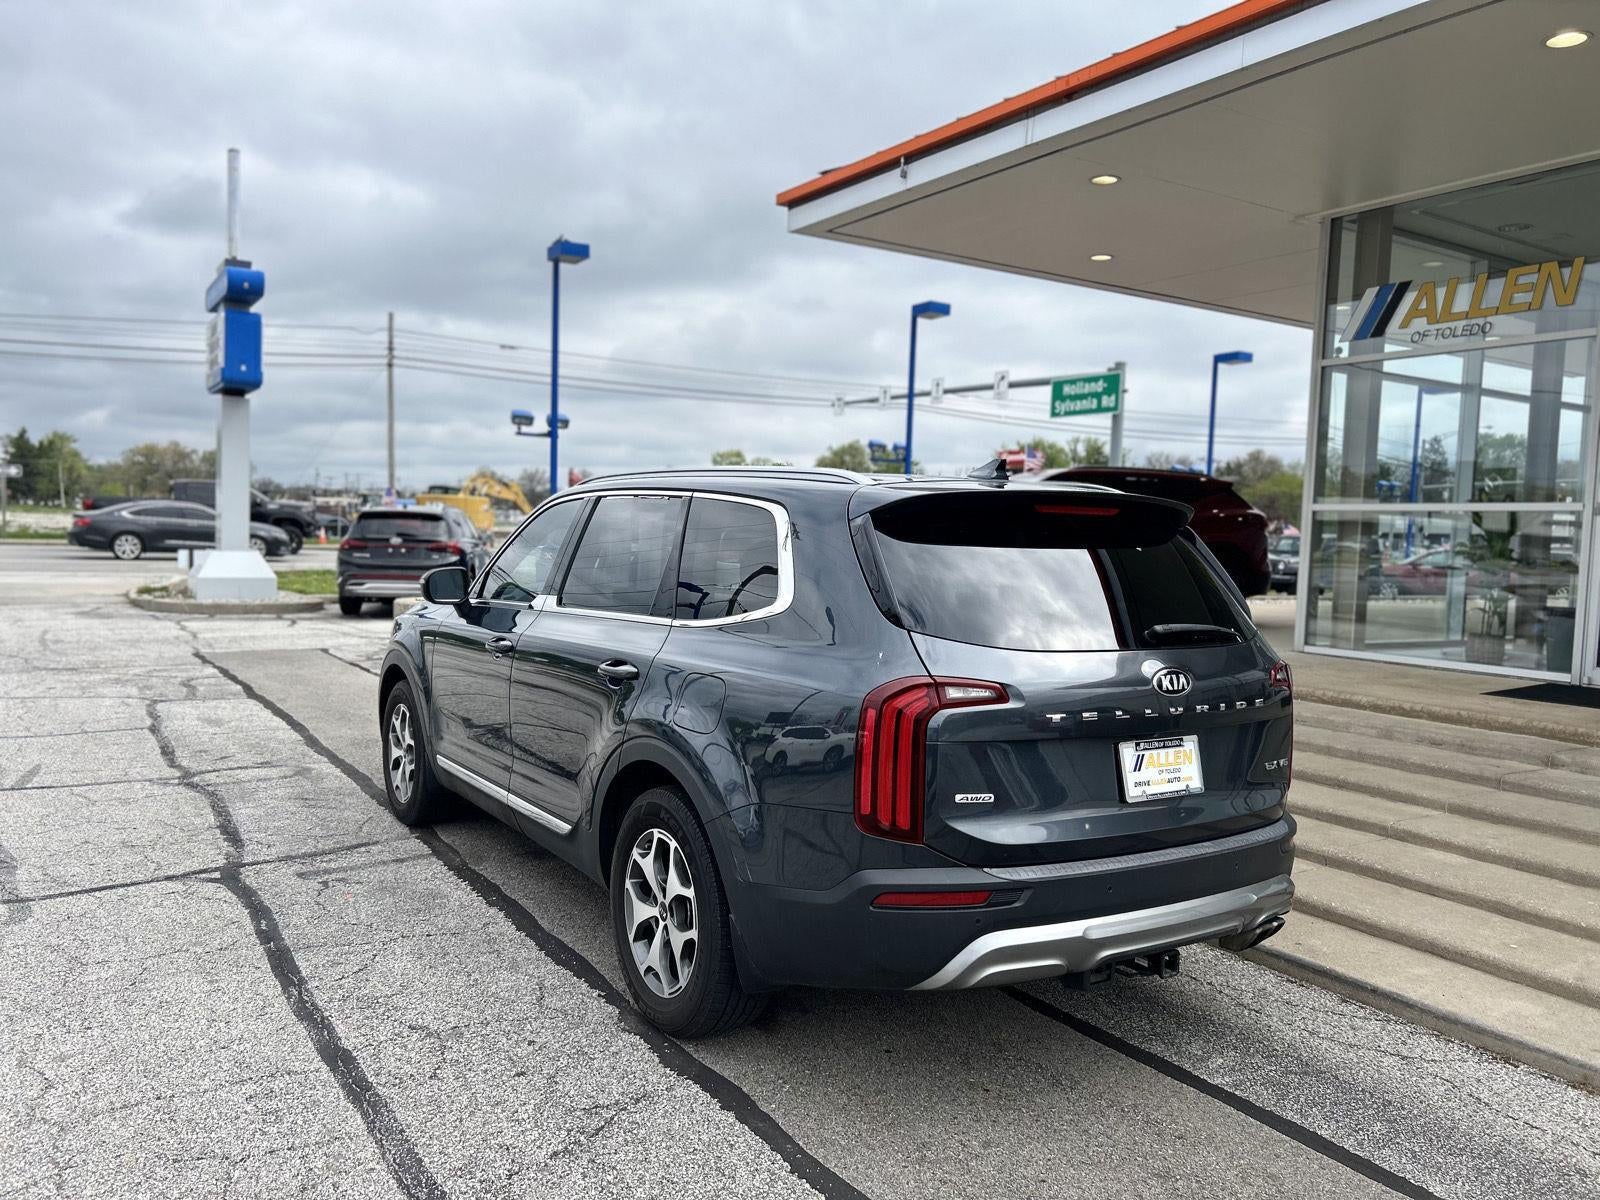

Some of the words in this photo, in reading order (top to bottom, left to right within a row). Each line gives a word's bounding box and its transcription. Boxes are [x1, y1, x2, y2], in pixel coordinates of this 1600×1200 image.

[1398, 256, 1585, 329] ALLEN
[1410, 330, 1430, 343] OF
[1434, 321, 1493, 341] TOLEDO
[1054, 397, 1098, 415] Sylvania
[1101, 393, 1116, 408] Rd
[1160, 674, 1188, 690] KIA
[1046, 698, 1264, 722] TELLURIDE
[1144, 741, 1158, 749] ALLEN
[1145, 749, 1193, 769] ALLEN
